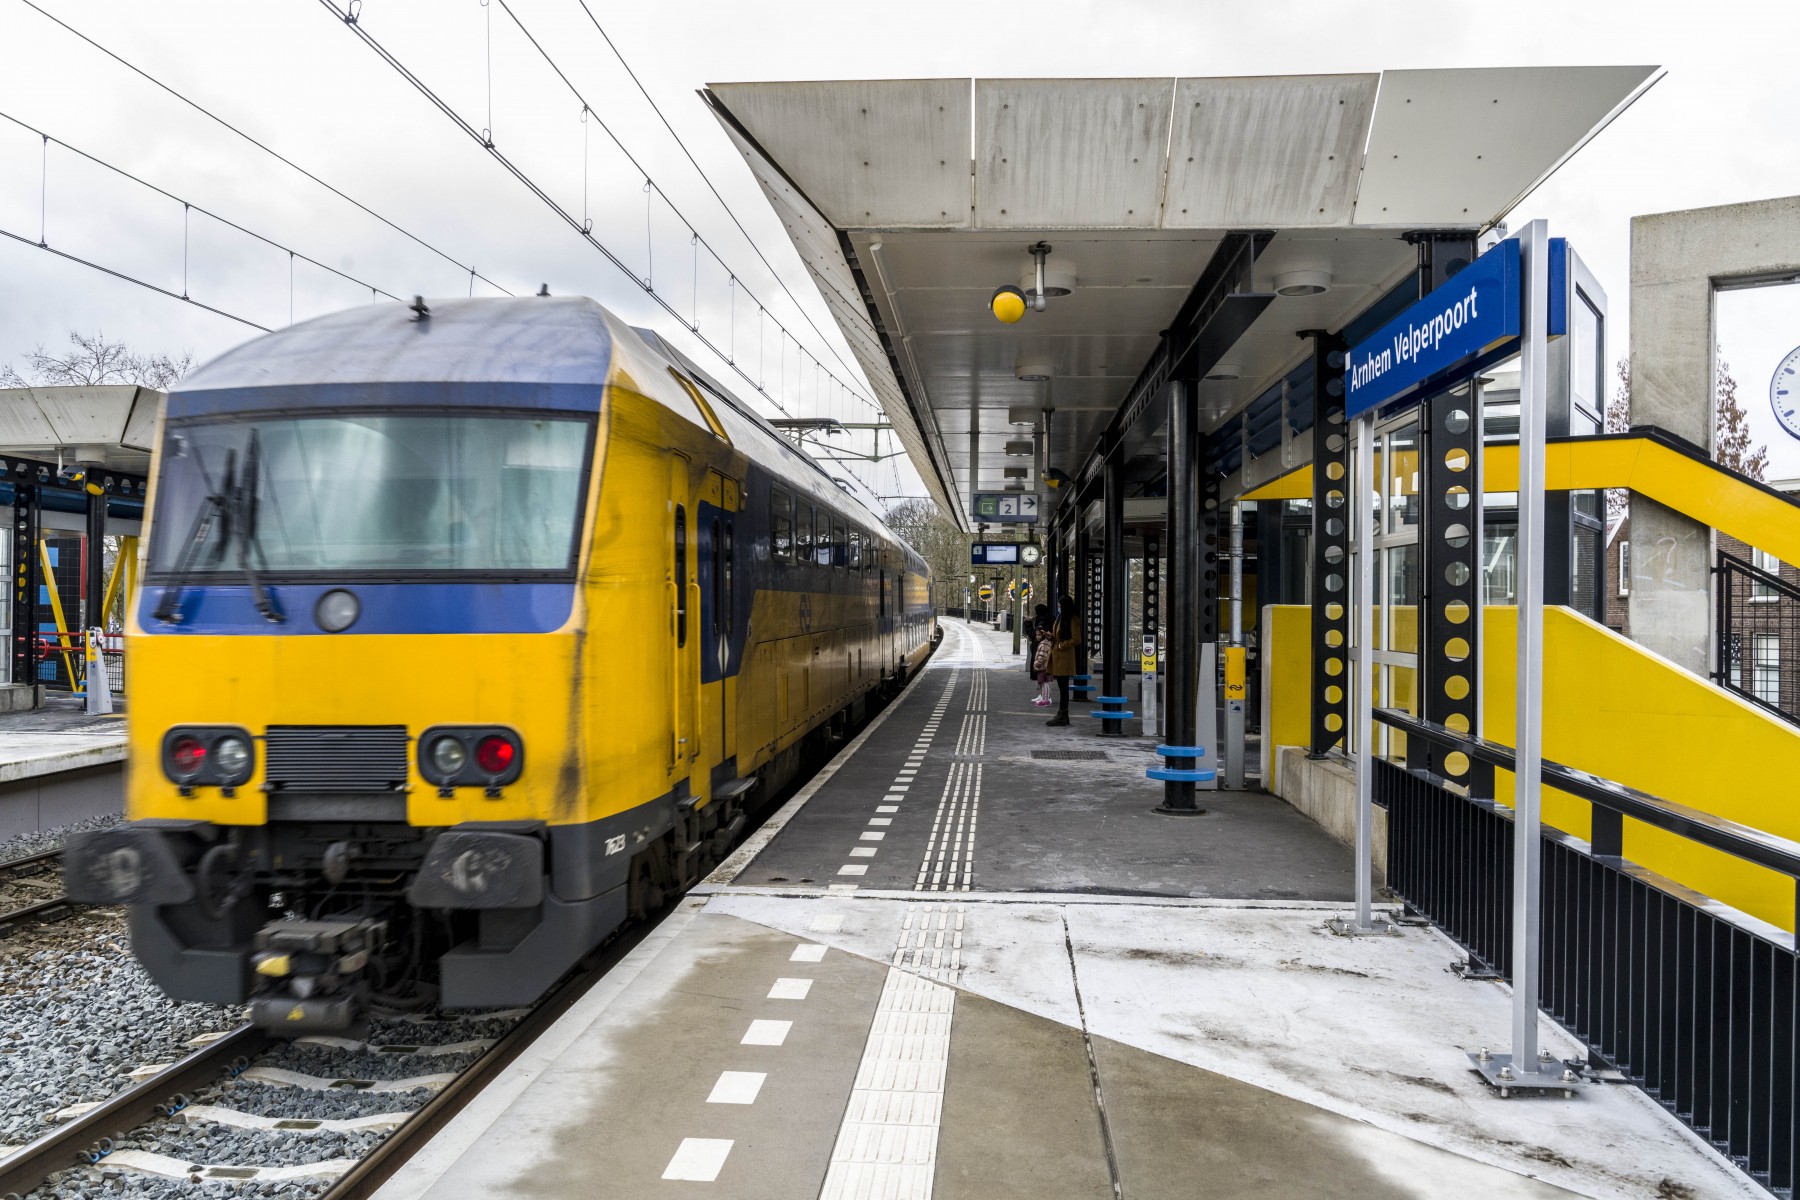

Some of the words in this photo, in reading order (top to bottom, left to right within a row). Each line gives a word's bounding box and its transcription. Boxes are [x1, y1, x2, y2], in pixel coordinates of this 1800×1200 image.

[1351, 348, 1391, 392] Arnhem
[1394, 286, 1477, 364] Velperpoort
[1004, 503, 1012, 514] 2
